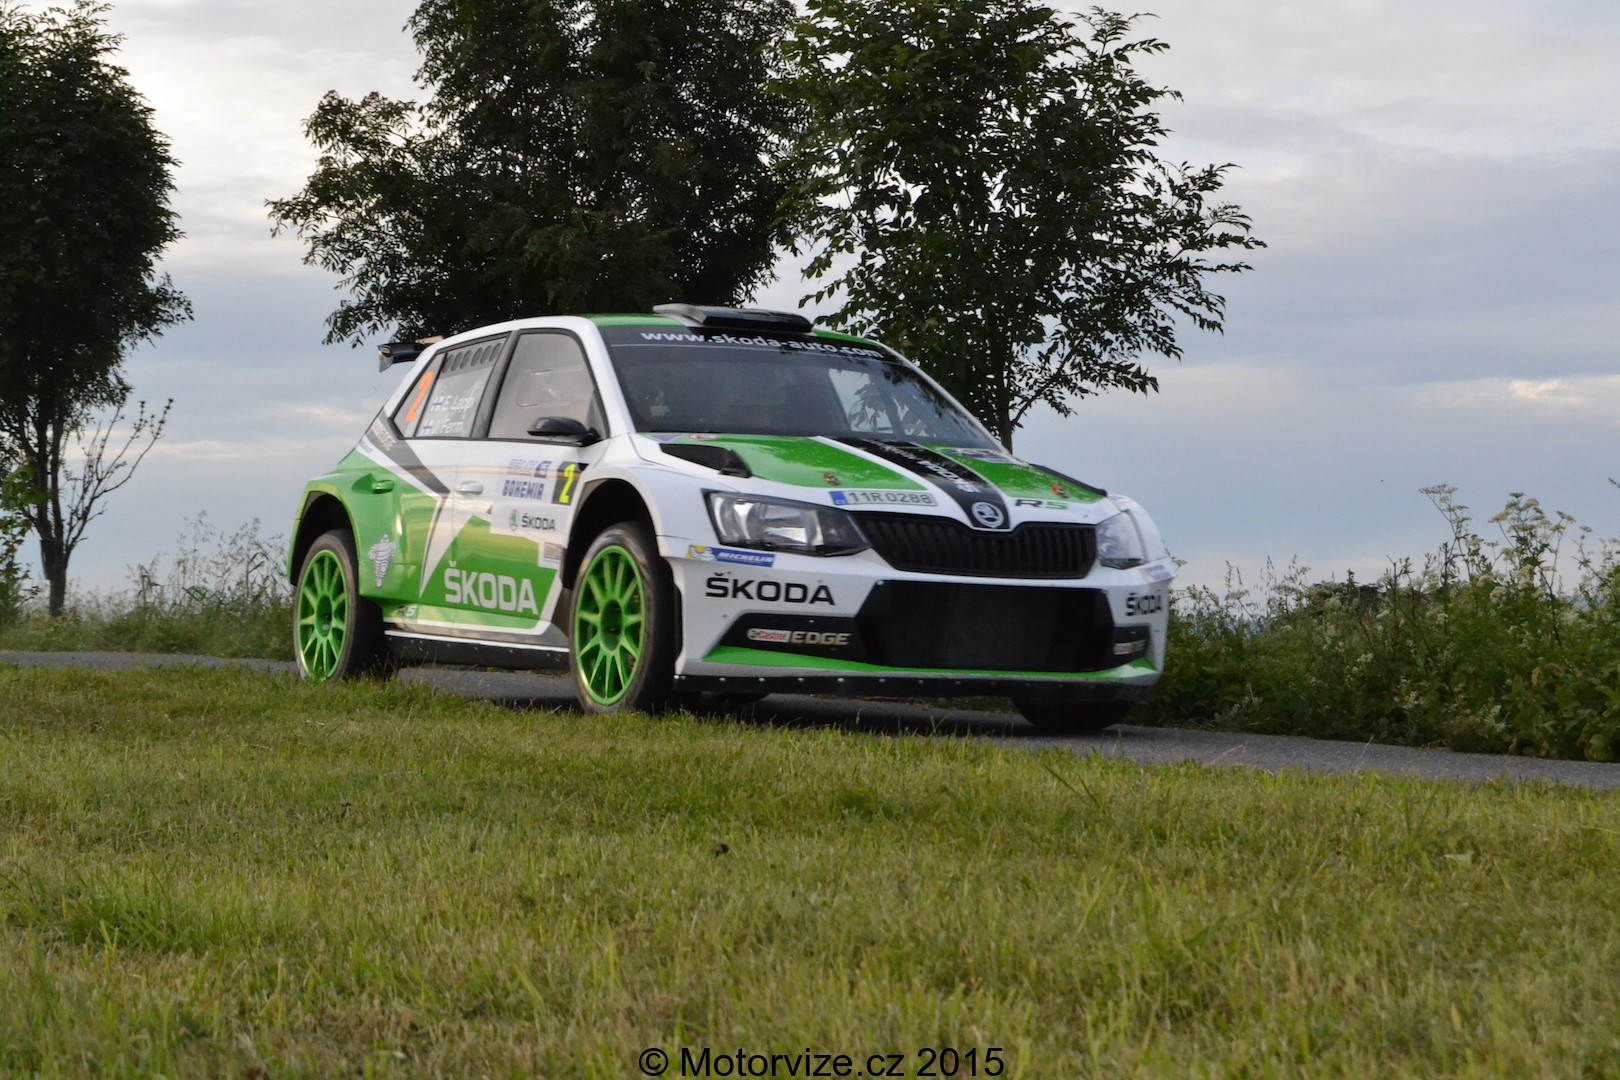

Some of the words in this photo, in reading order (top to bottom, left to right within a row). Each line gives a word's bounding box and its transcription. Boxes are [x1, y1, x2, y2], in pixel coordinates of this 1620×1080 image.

[640, 331, 884, 359] www.skoda-auto.com
[559, 463, 577, 504] 2
[848, 492, 882, 502] 11R
[884, 492, 933, 504] 0288
[1015, 499, 1069, 510] RS
[521, 512, 556, 531] ŠKODA
[443, 560, 539, 616] ŠKODA
[705, 571, 836, 606] ŠKODA
[790, 630, 852, 646] EDGE
